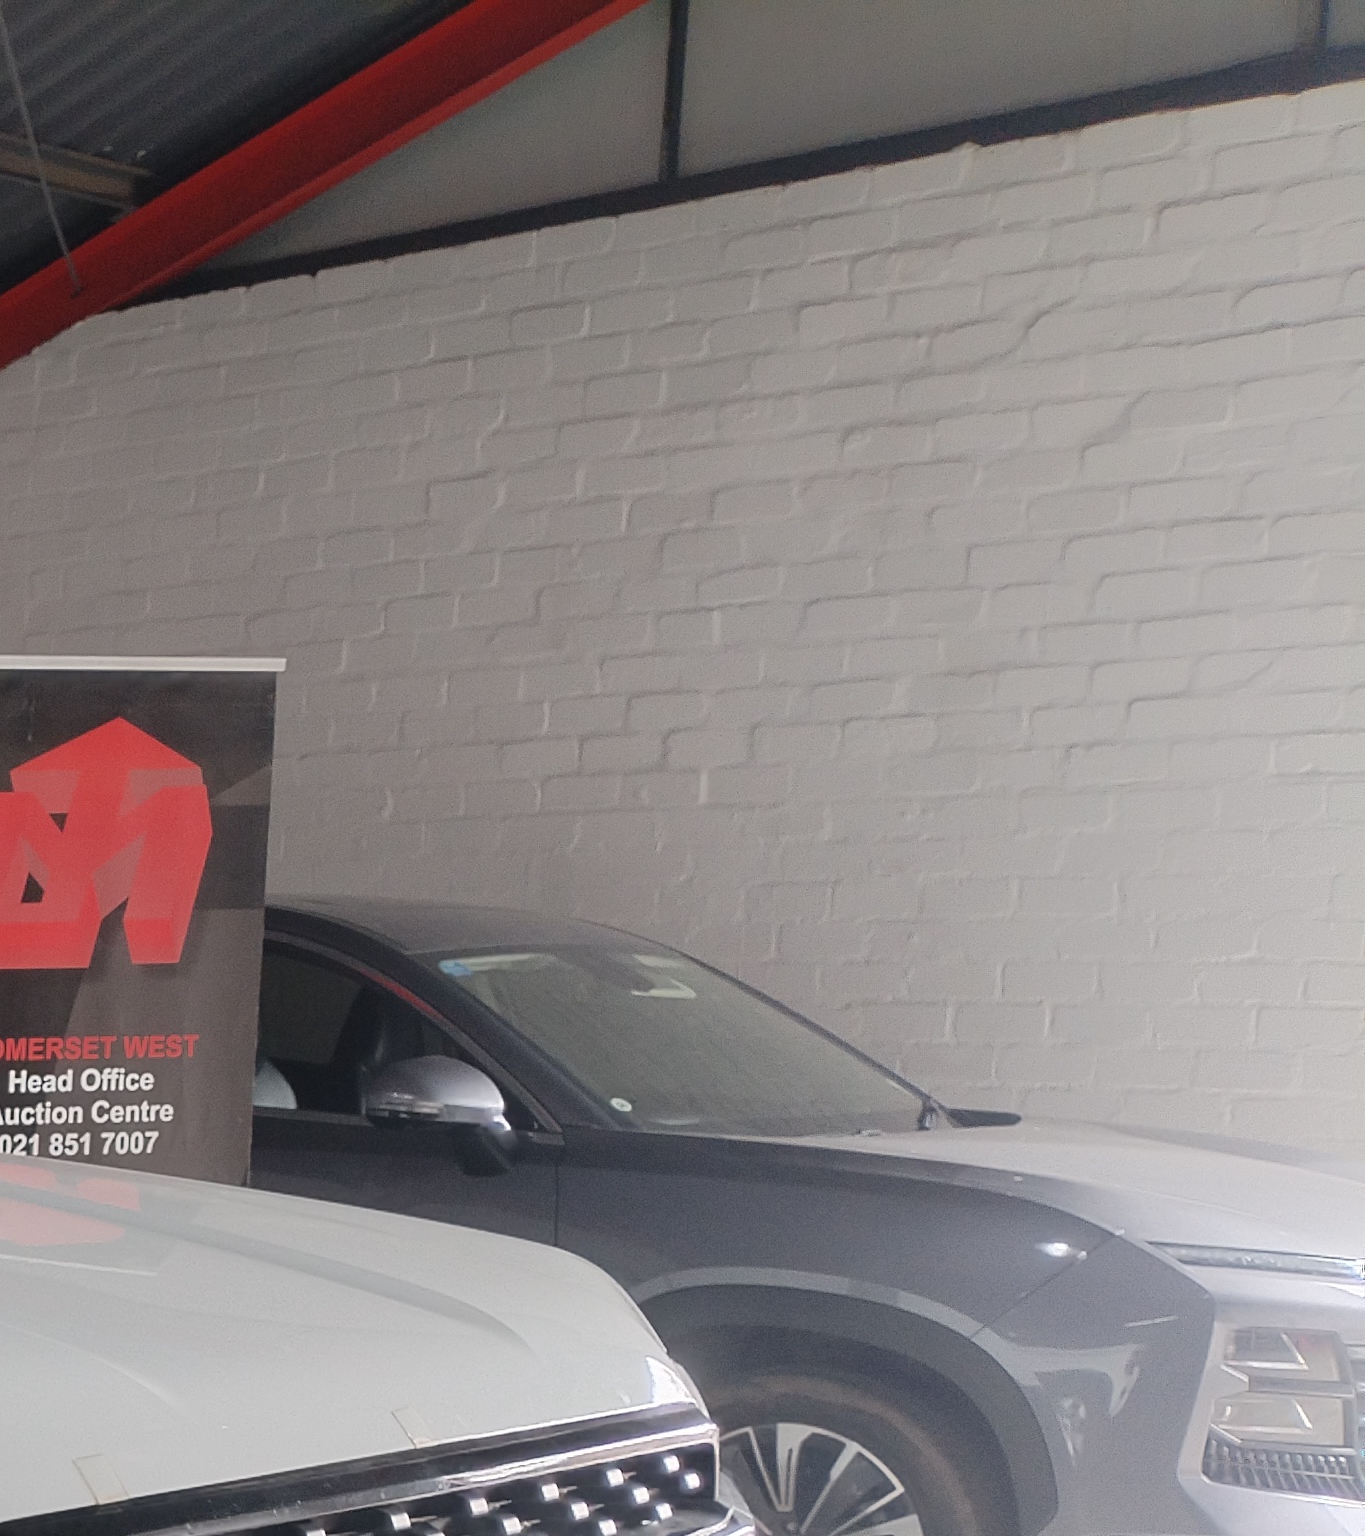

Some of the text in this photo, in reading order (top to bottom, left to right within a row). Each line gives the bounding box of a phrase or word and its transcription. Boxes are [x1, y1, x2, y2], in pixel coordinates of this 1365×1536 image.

[123, 1034, 200, 1059] WEST
[8, 1067, 155, 1094] Head Office
[91, 1099, 175, 1123] Centre
[49, 1132, 91, 1156] 851
[100, 1131, 159, 1155] 7007
